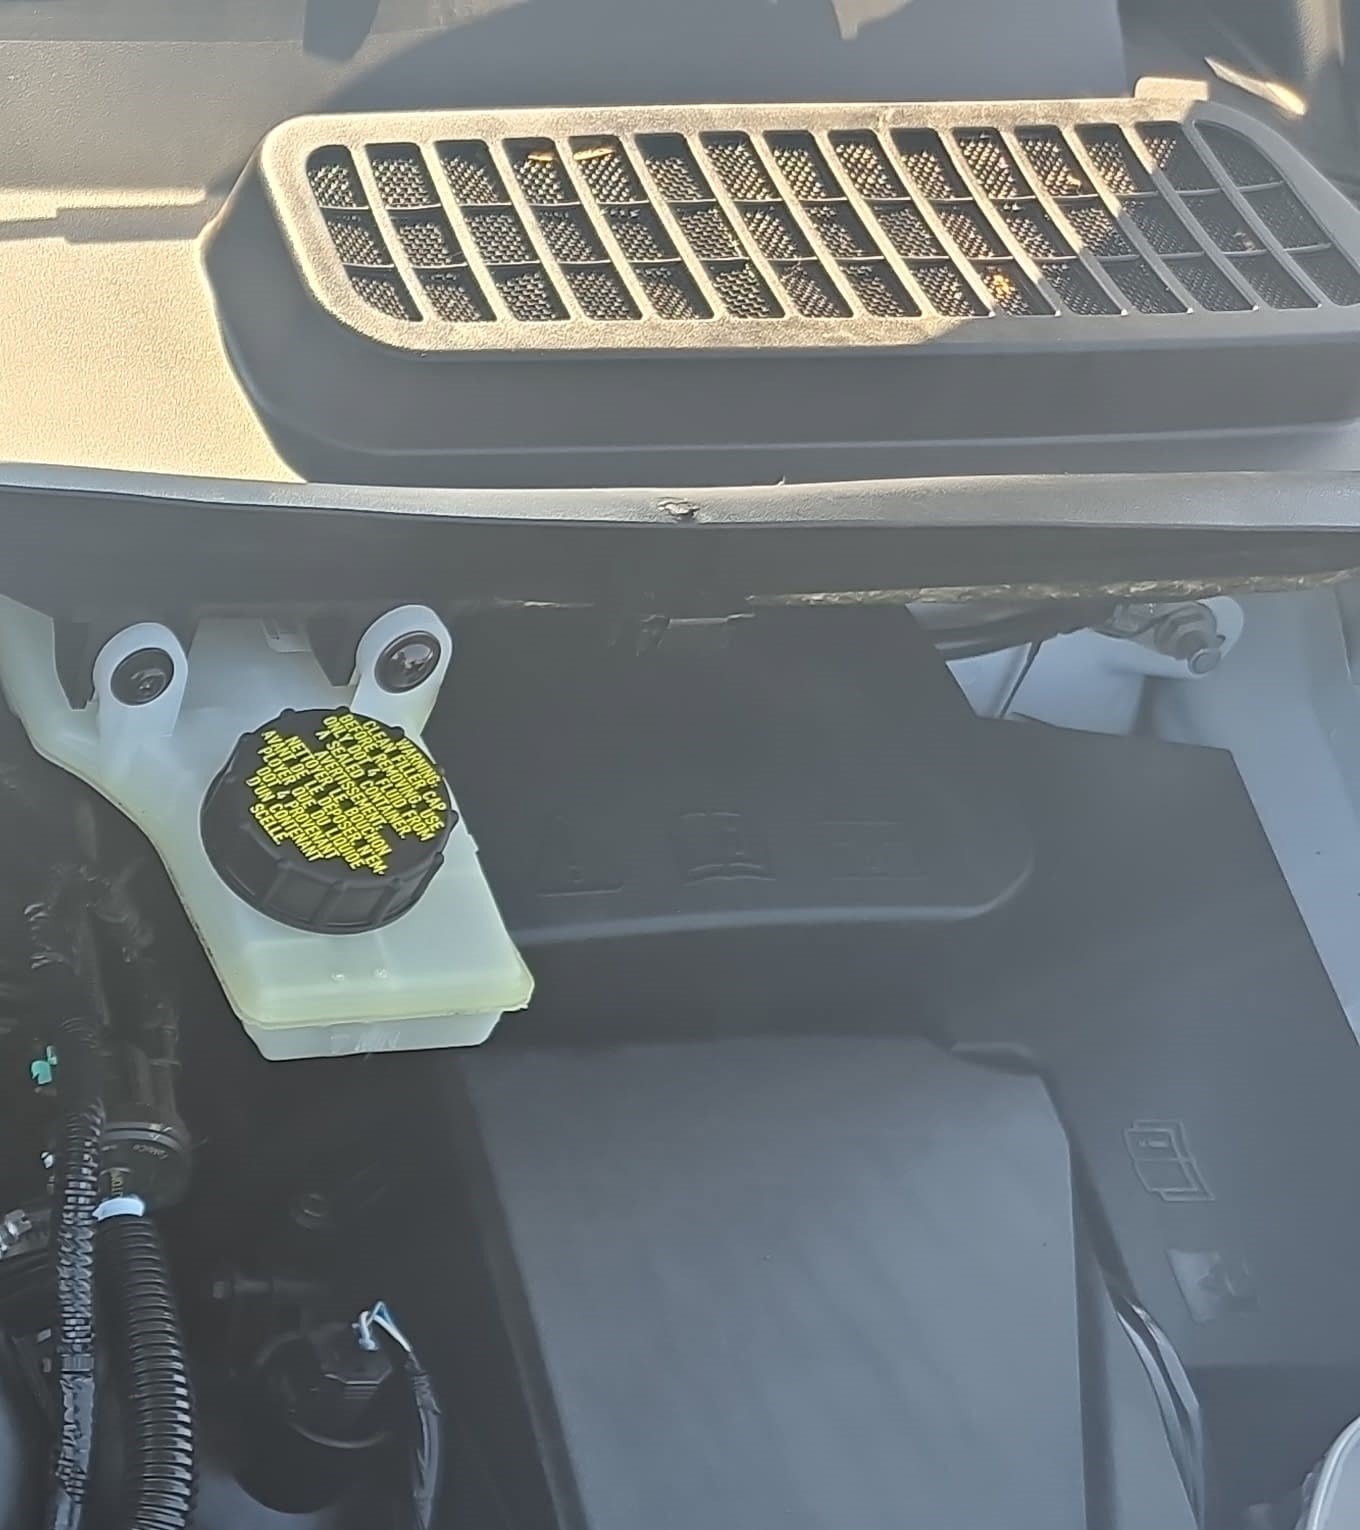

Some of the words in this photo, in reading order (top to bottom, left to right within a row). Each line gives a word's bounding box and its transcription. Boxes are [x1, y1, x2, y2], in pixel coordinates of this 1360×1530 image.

[262, 731, 296, 761] AVANT
[290, 764, 308, 778] DE
[304, 781, 322, 795] LE
[285, 737, 332, 785] NETTOYER
[329, 789, 347, 803] LE
[345, 808, 391, 855] BOUCHON
[315, 731, 330, 741] A
[326, 742, 363, 778] SEALED
[315, 752, 387, 829] AVERTISSEMENT:
[323, 716, 351, 739] ONLY
[347, 745, 371, 764] DOT
[367, 767, 380, 778] 4
[375, 779, 405, 807] FLUID
[402, 811, 434, 840] FROM
[339, 714, 377, 751] BEFORE
[420, 809, 443, 830] USE
[363, 720, 395, 752] CLEAN
[391, 755, 425, 788] FILLER
[422, 791, 446, 812] CAP
[396, 738, 440, 788] WARNING:
[246, 777, 273, 802] D'UN
[268, 804, 322, 860] CONTENANT
[256, 768, 280, 787] DOT
[276, 790, 290, 800] 4
[284, 801, 338, 857] PROVENANT
[258, 748, 295, 785] PLOYER
[291, 787, 314, 808] QUE
[311, 810, 331, 827] DU
[325, 829, 364, 869] LIQUIDE
